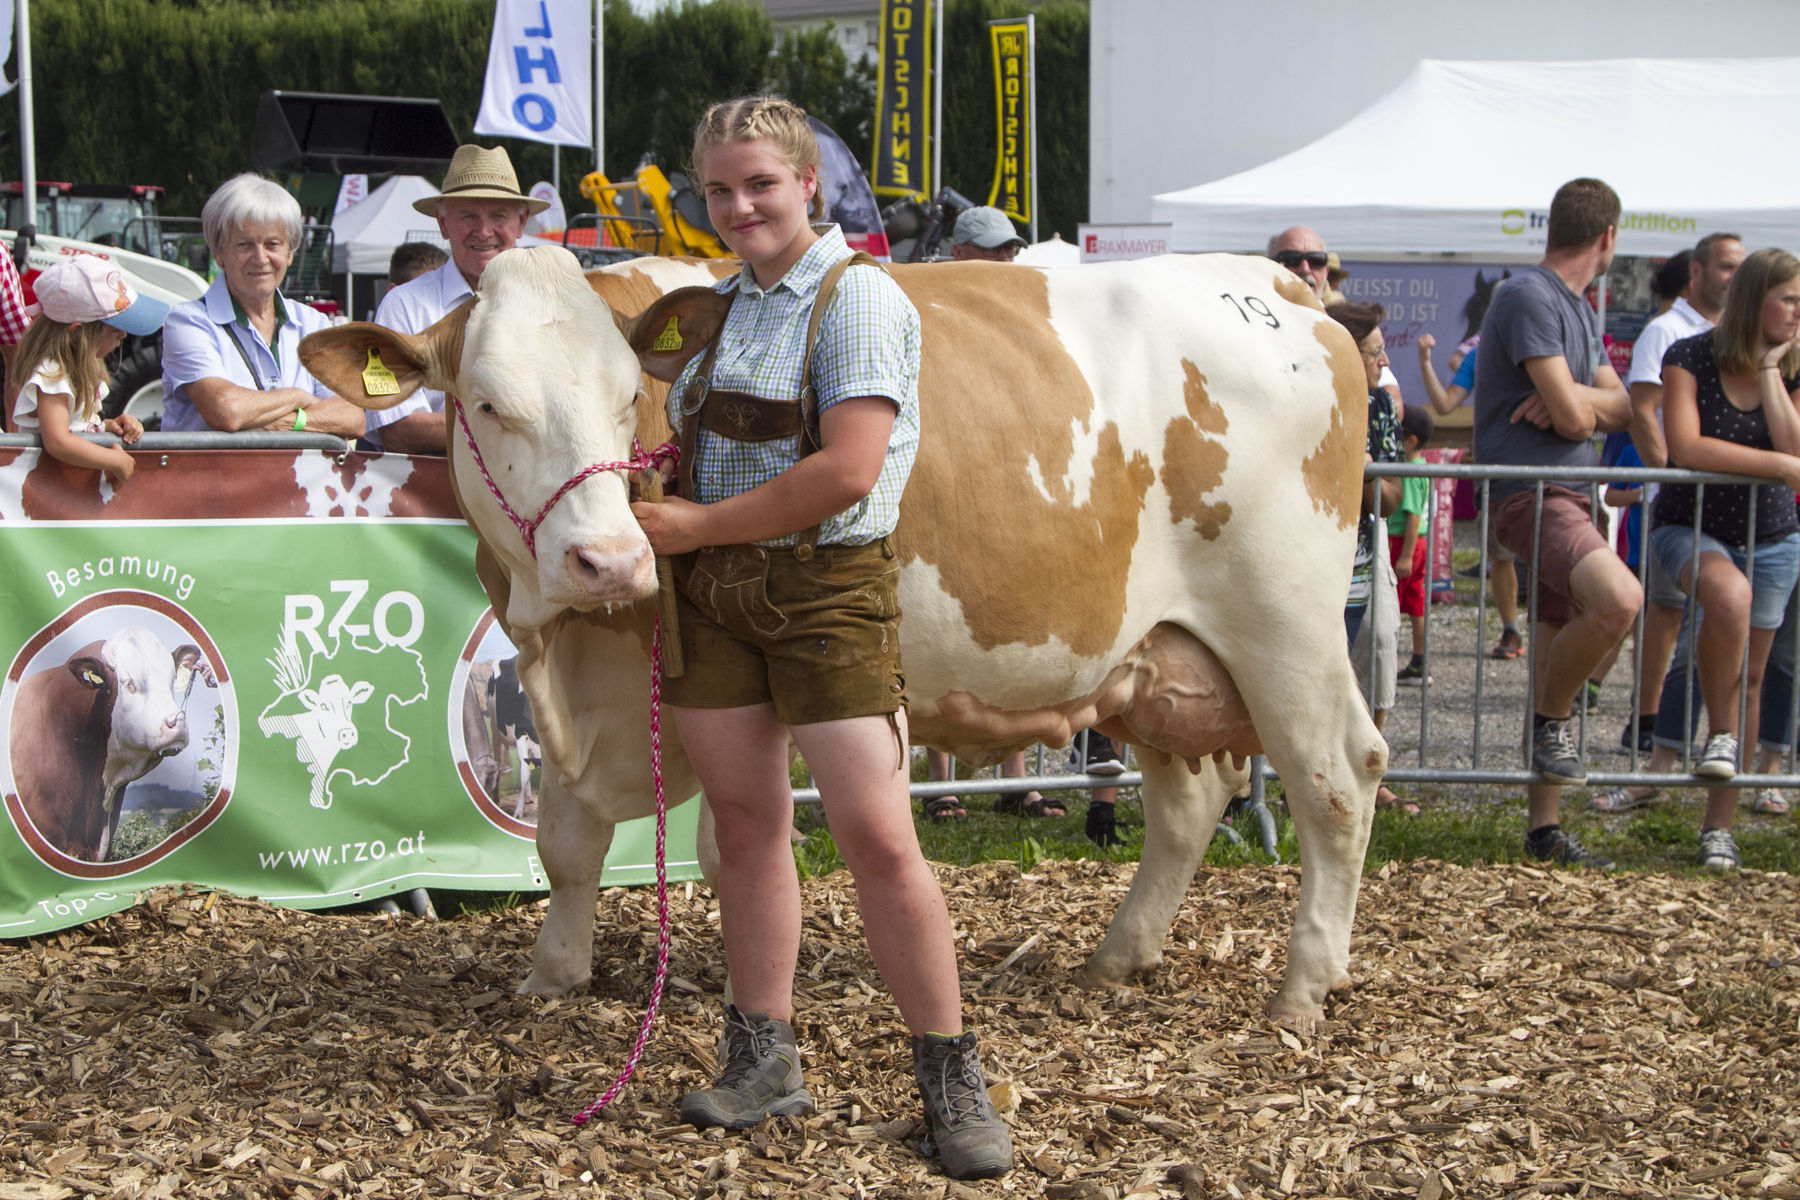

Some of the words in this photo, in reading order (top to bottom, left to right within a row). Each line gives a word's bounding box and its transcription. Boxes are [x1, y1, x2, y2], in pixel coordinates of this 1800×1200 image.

[1618, 212, 1696, 232] utrition
[1384, 304, 1405, 321] ND
[1411, 304, 1440, 321] IST
[46, 556, 196, 601] Besamung
[284, 579, 425, 654] RZO
[258, 830, 426, 870] www.rzo.at
